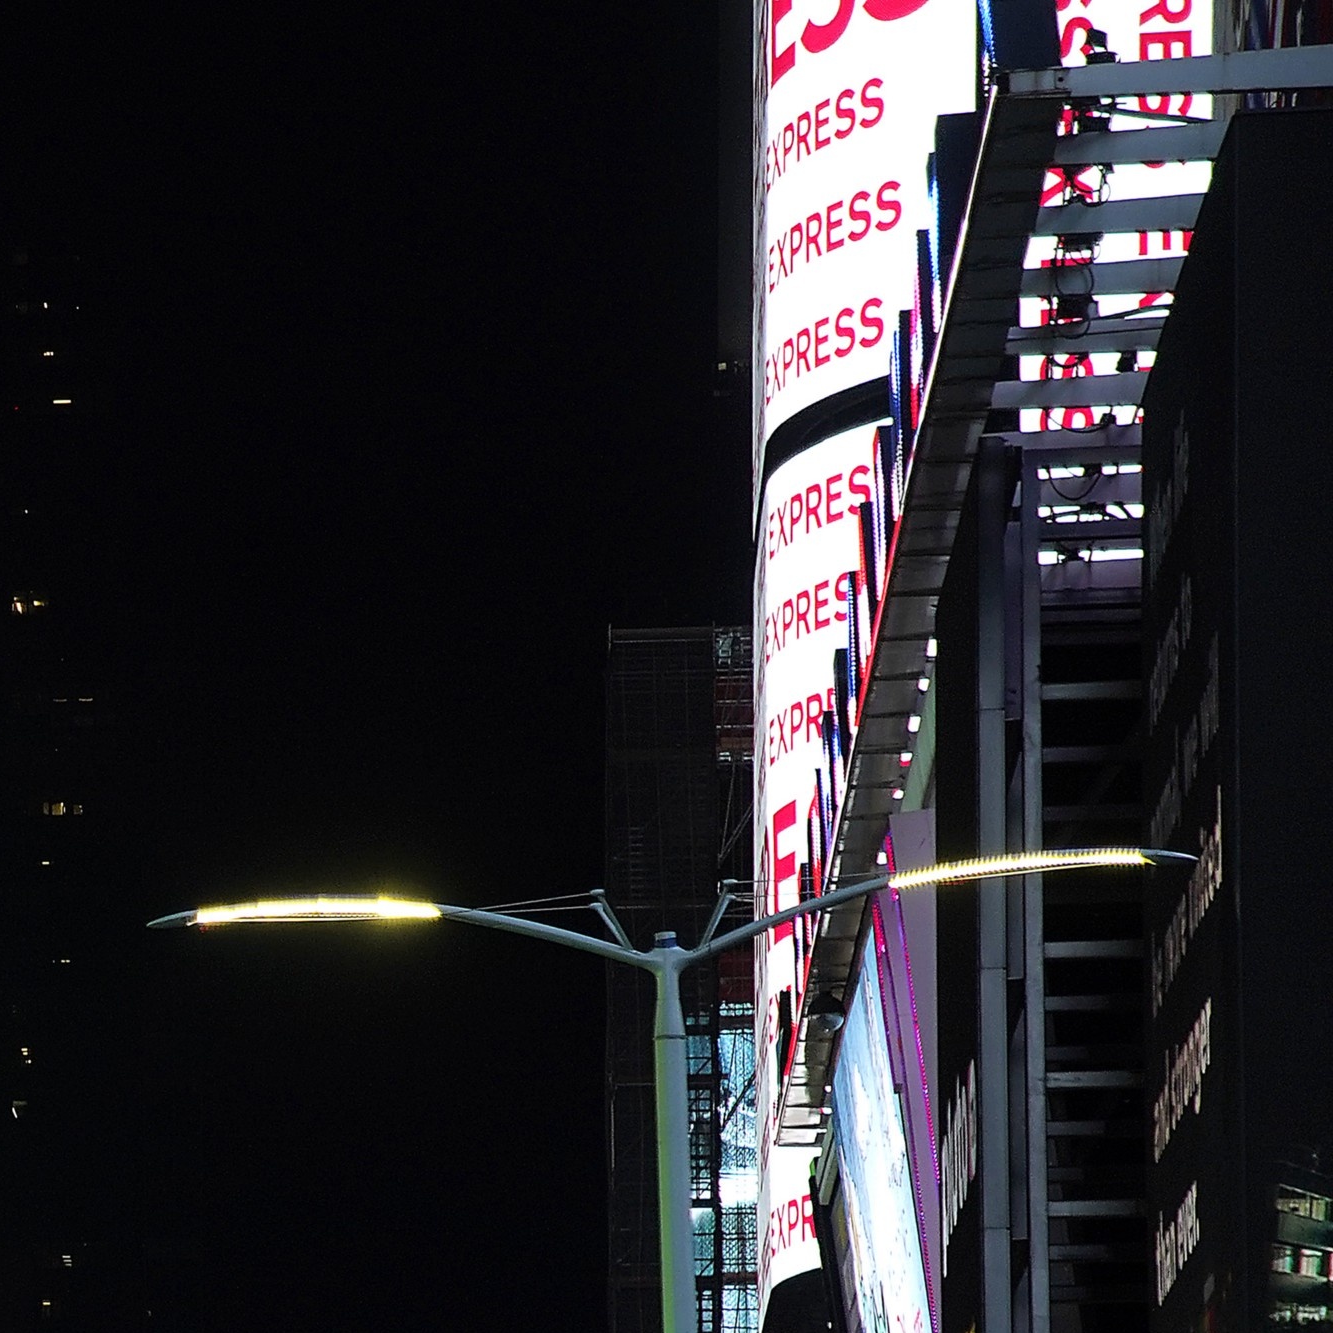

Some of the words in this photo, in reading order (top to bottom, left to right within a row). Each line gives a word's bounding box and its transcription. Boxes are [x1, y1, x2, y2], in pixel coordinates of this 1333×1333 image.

[766, 78, 884, 194] EXPRESS
[768, 180, 902, 294] EXPRESS
[766, 297, 884, 403] EXPRESS
